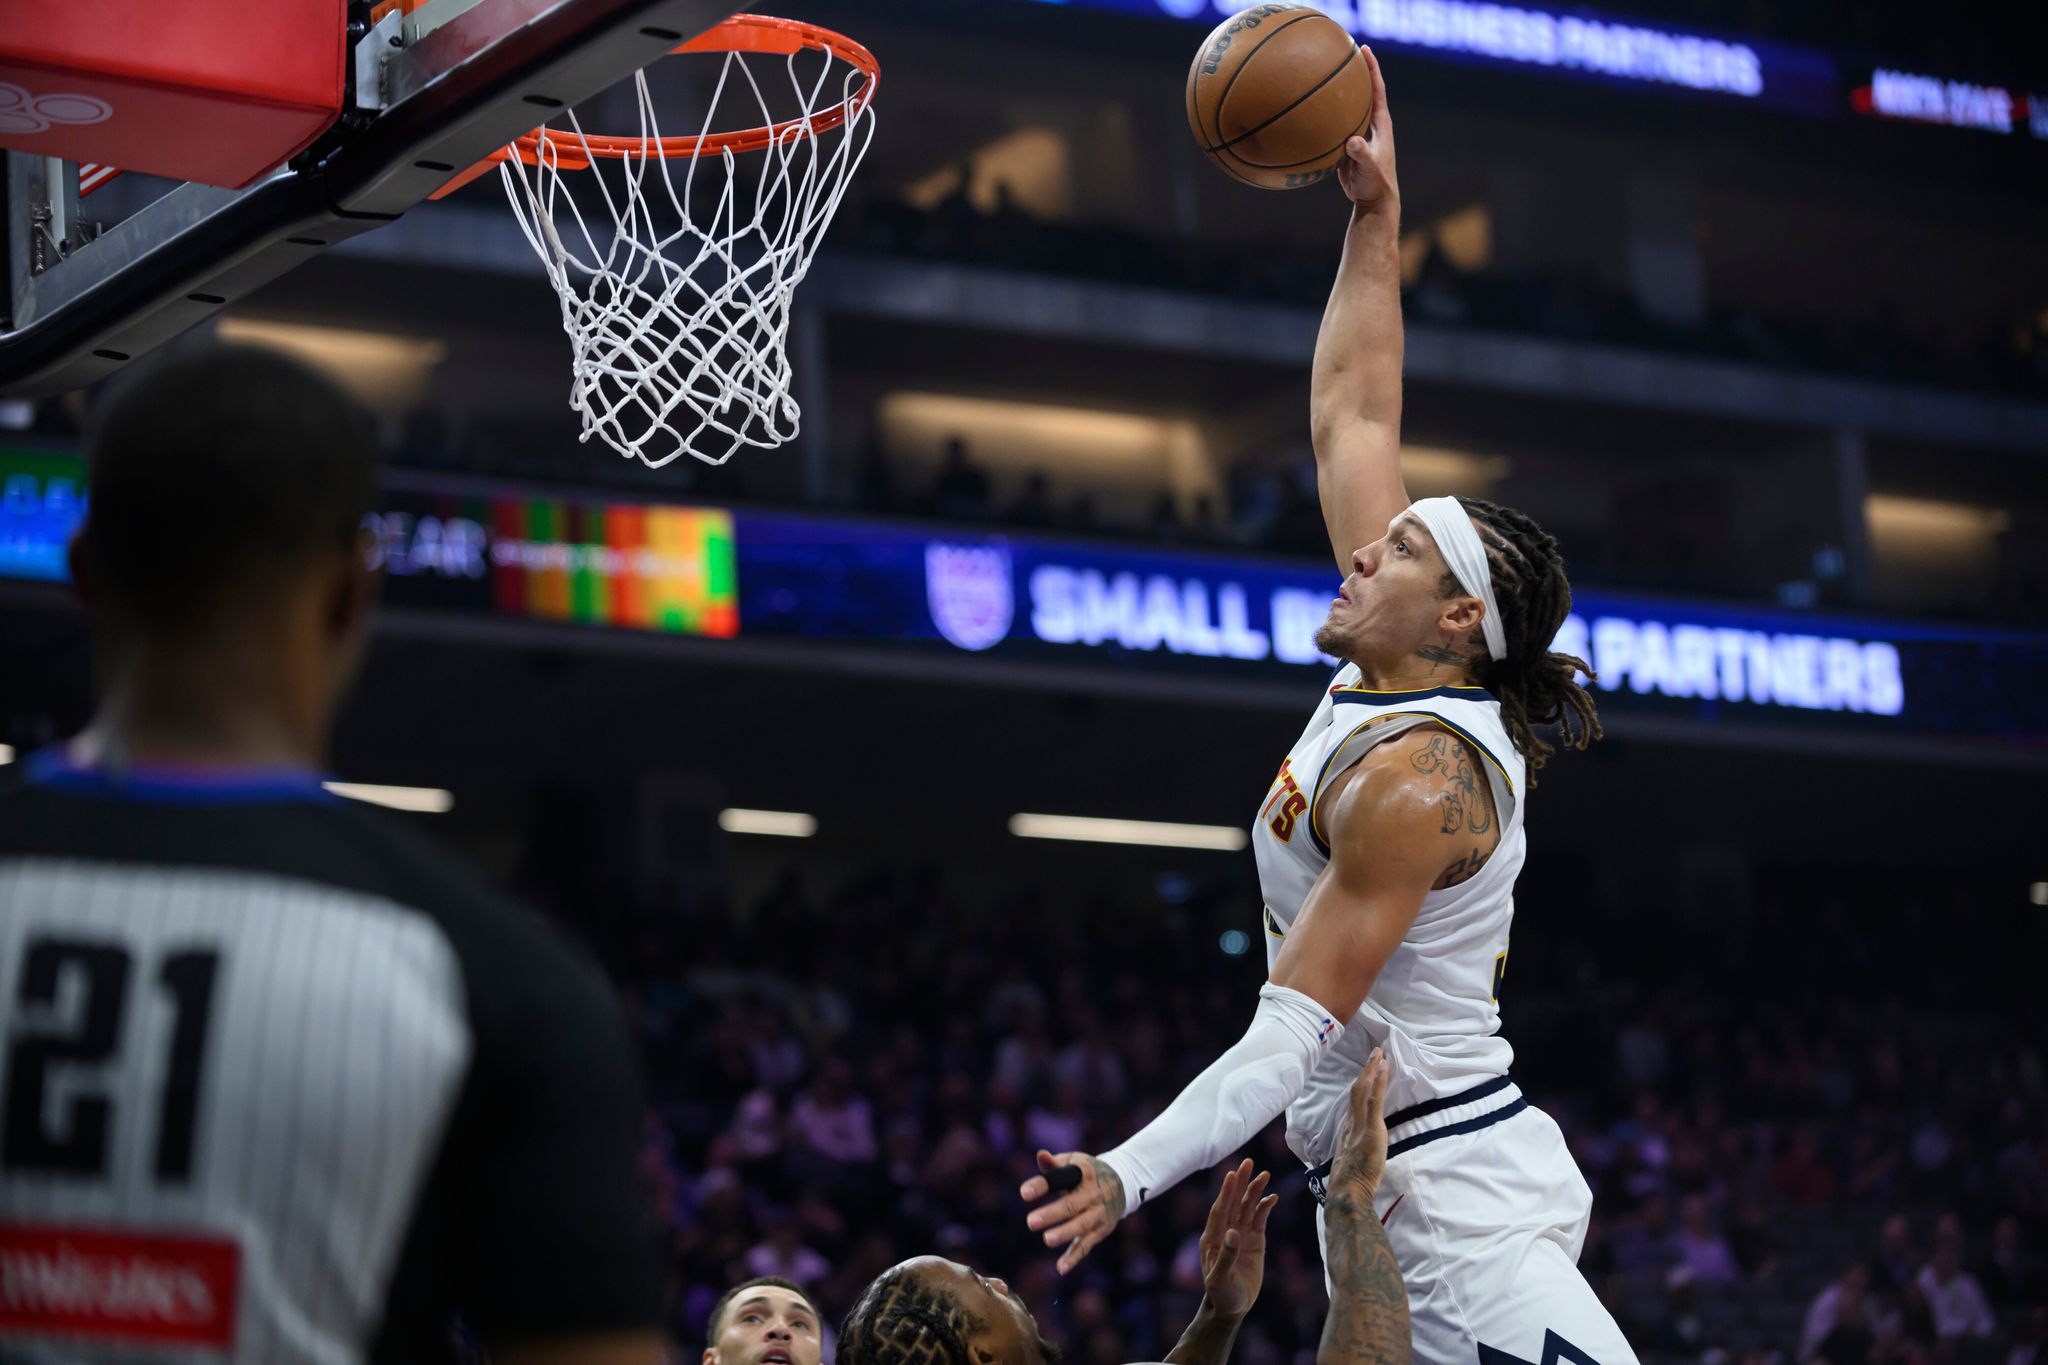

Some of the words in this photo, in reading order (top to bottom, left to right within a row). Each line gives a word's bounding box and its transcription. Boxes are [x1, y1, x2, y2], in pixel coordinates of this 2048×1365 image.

[1029, 564, 1271, 662] SMALL
[1592, 615, 1905, 717] PARTNERS
[2, 936, 222, 1192] 21
